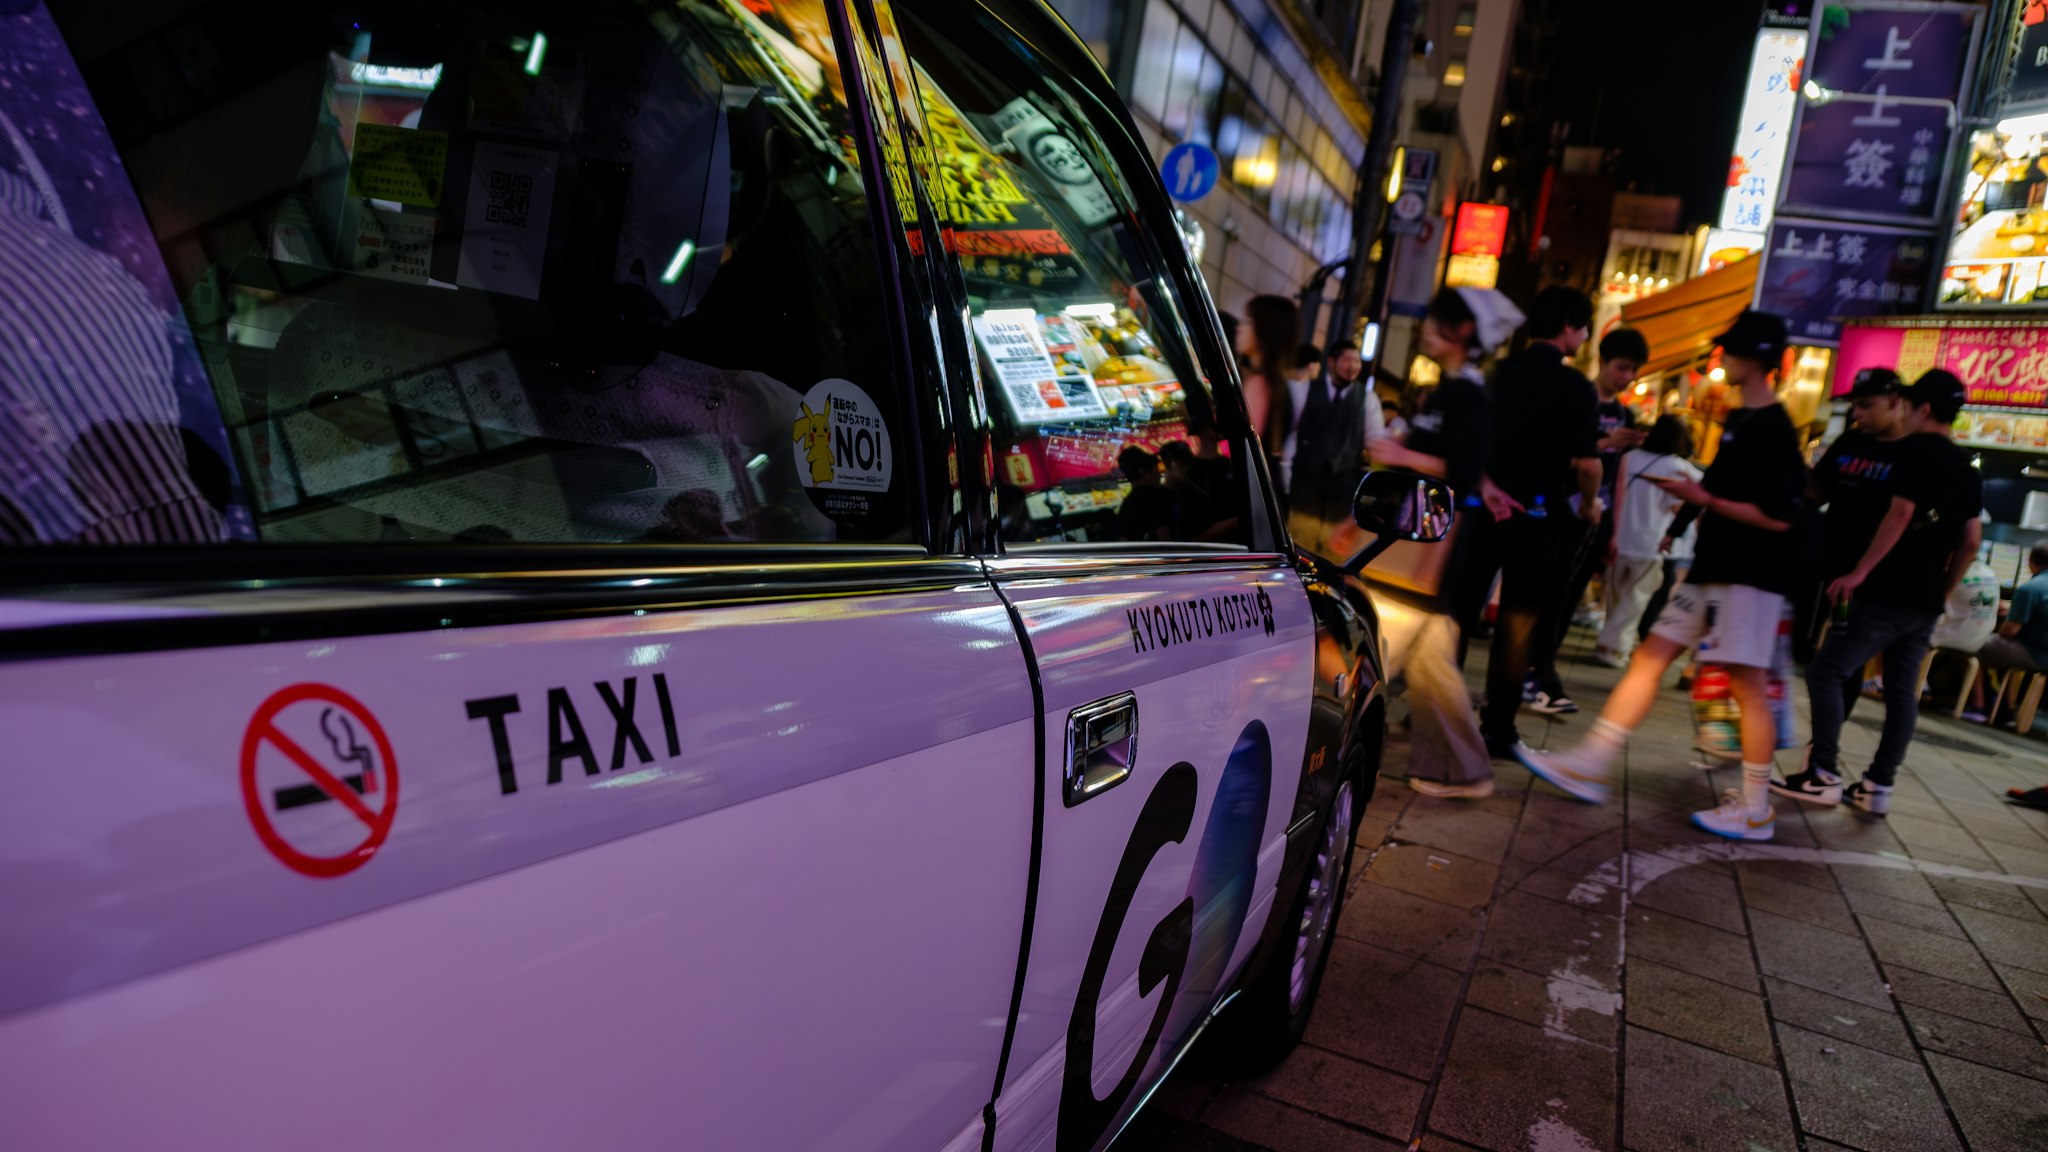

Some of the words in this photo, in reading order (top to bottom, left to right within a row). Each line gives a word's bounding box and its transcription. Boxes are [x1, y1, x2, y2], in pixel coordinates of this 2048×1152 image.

[1774, 229, 1868, 265] 上上簽
[833, 397, 858, 412] 運転中の
[833, 411, 880, 429] 「ながらスマホ」は
[835, 425, 883, 472] NO!
[1126, 597, 1213, 654] KYOKUTO
[1213, 592, 1259, 635] KOTSU
[464, 672, 681, 796] TAXI
